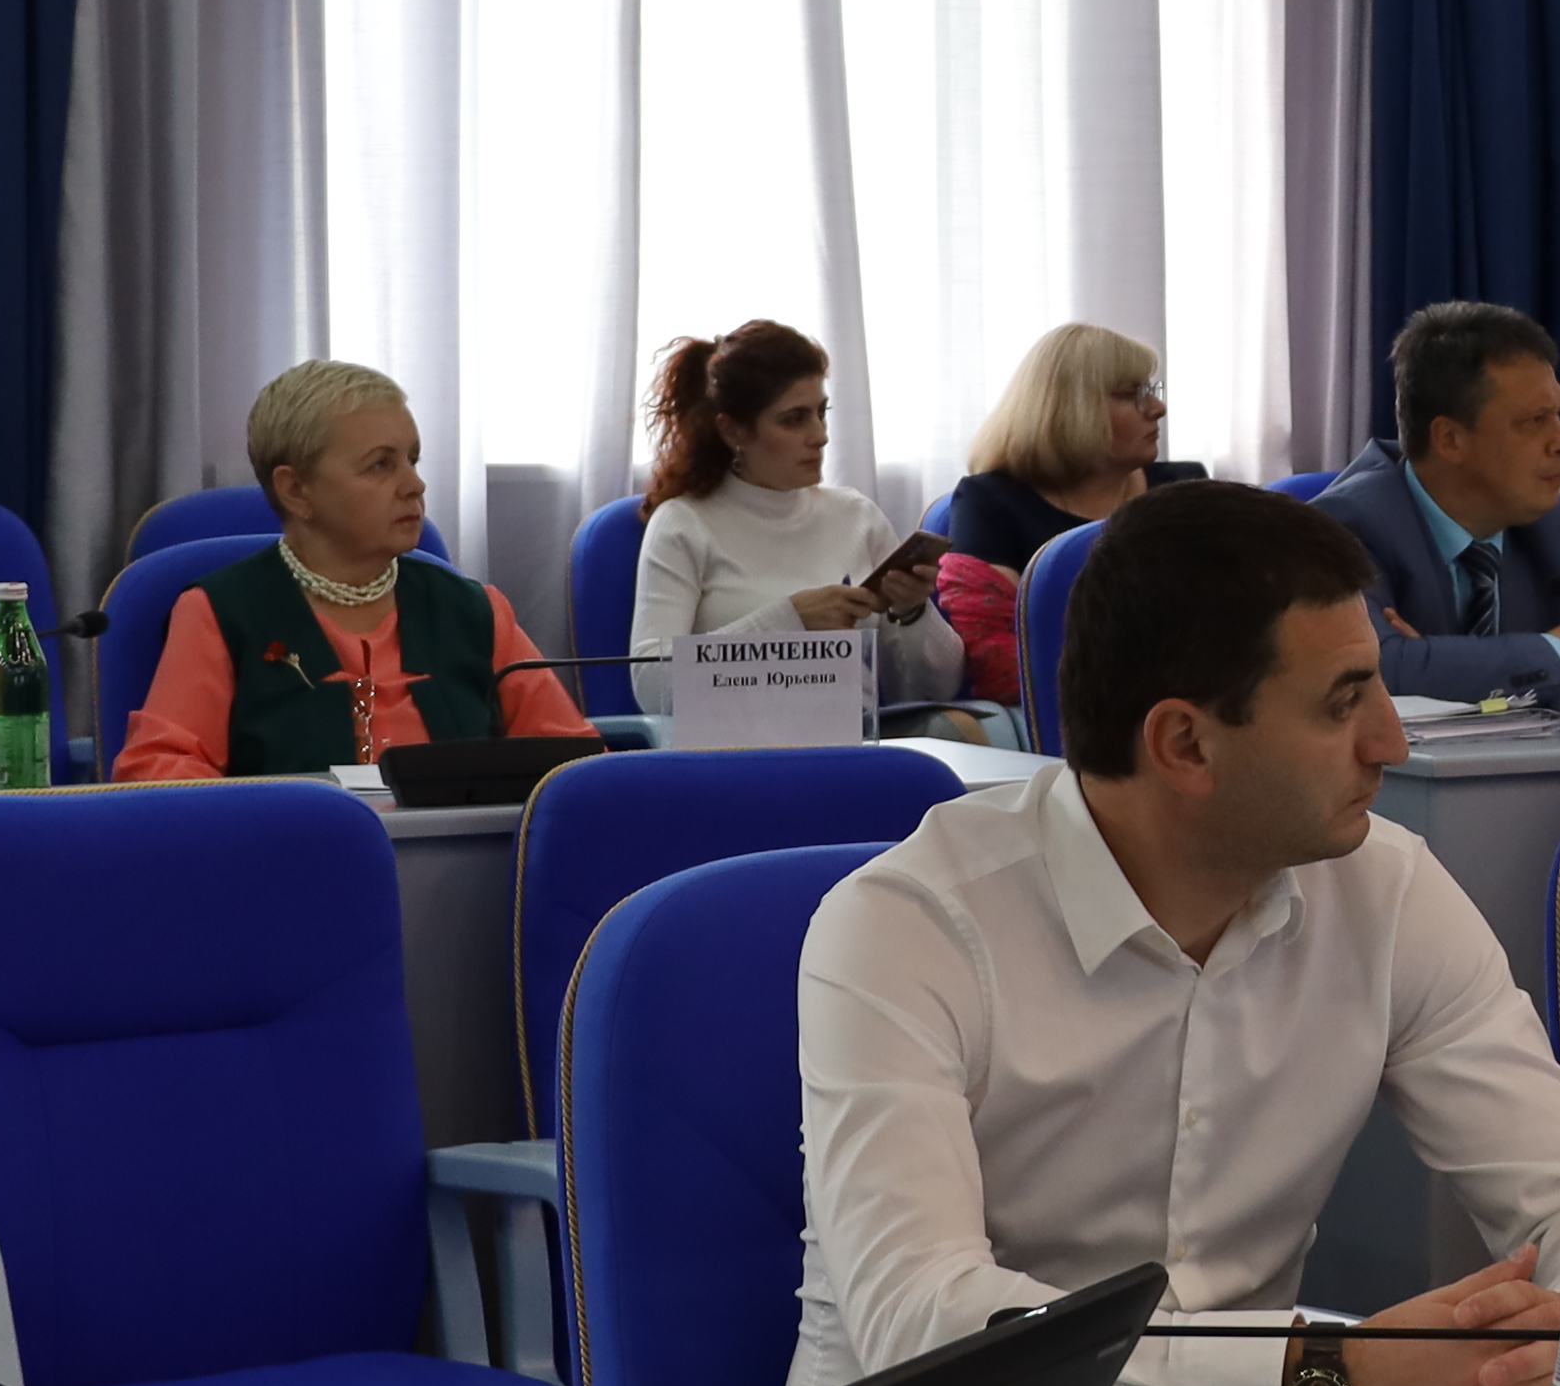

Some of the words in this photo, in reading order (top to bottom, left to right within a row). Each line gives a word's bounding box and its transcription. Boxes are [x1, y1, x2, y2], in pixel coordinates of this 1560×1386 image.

[695, 639, 853, 664] КЛИМЧЕНКО
[712, 673, 758, 688] Елена
[766, 670, 837, 689] Юрьевна
